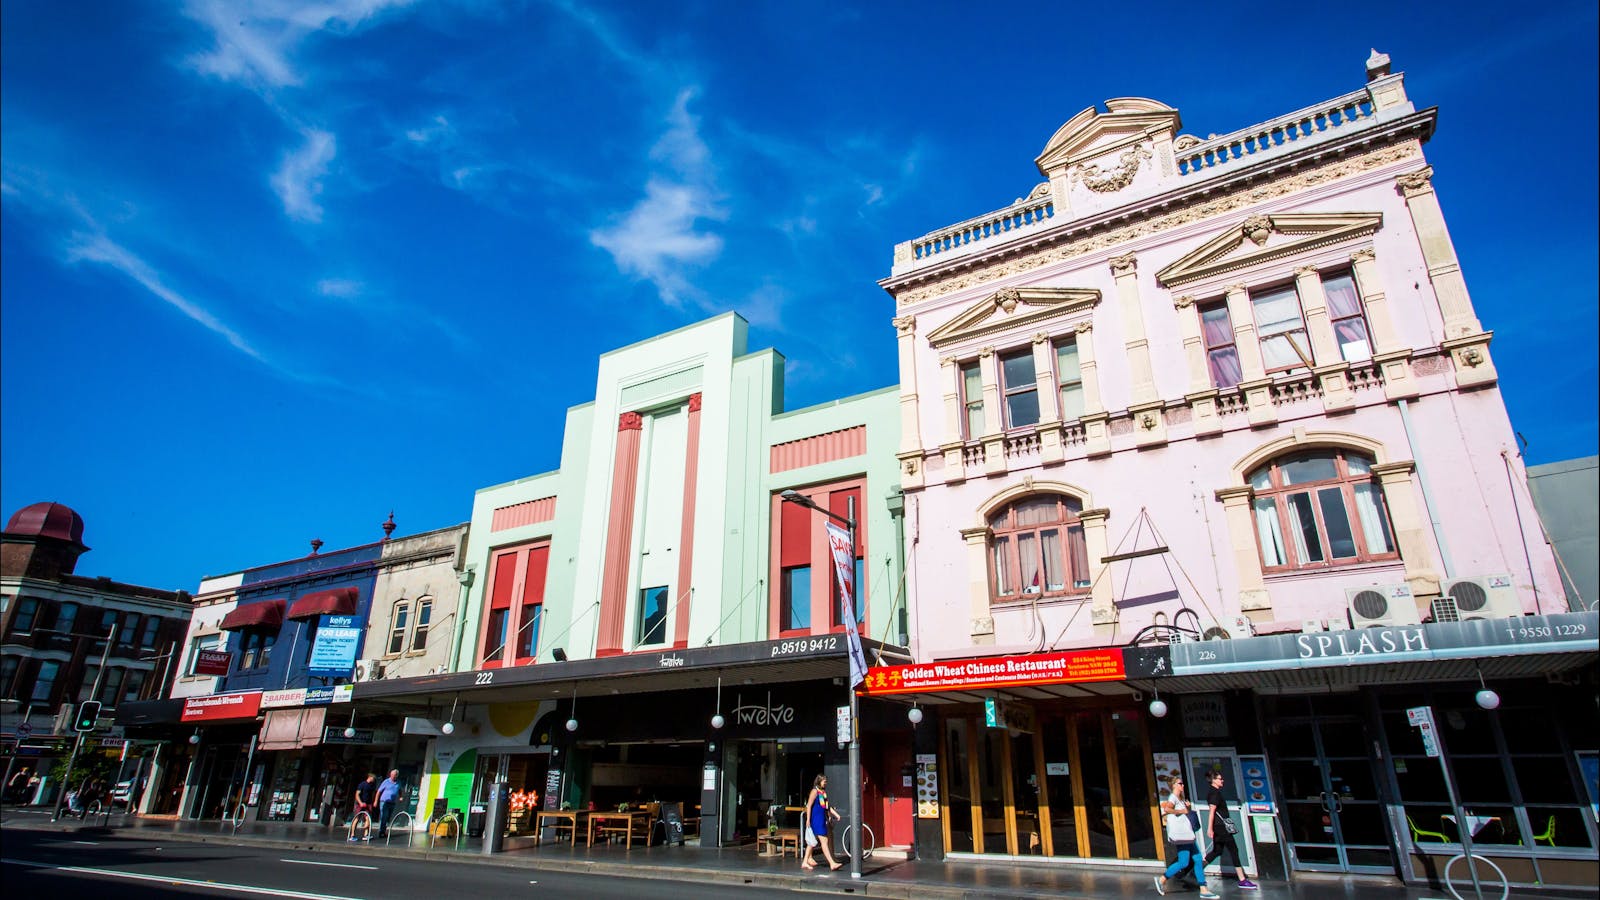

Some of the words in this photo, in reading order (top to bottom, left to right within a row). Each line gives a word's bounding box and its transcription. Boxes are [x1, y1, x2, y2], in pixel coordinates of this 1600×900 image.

[329, 616, 352, 625] kellys
[316, 629, 334, 637] FOR
[335, 629, 357, 637] LEASE
[1505, 628, 1516, 639] T
[1519, 626, 1552, 638] 9550
[1555, 623, 1586, 636] 1229
[771, 640, 808, 658] p.9519
[809, 637, 837, 651] 9412
[1297, 628, 1430, 658] SPLASH
[658, 651, 684, 668] twelve
[1198, 650, 1217, 661] 226
[901, 667, 935, 680] Golden
[934, 664, 966, 678] Wheat
[966, 662, 1006, 676] Chinese
[1006, 657, 1067, 673] Restaurant
[475, 671, 493, 685] 222
[731, 690, 794, 726] twelve
